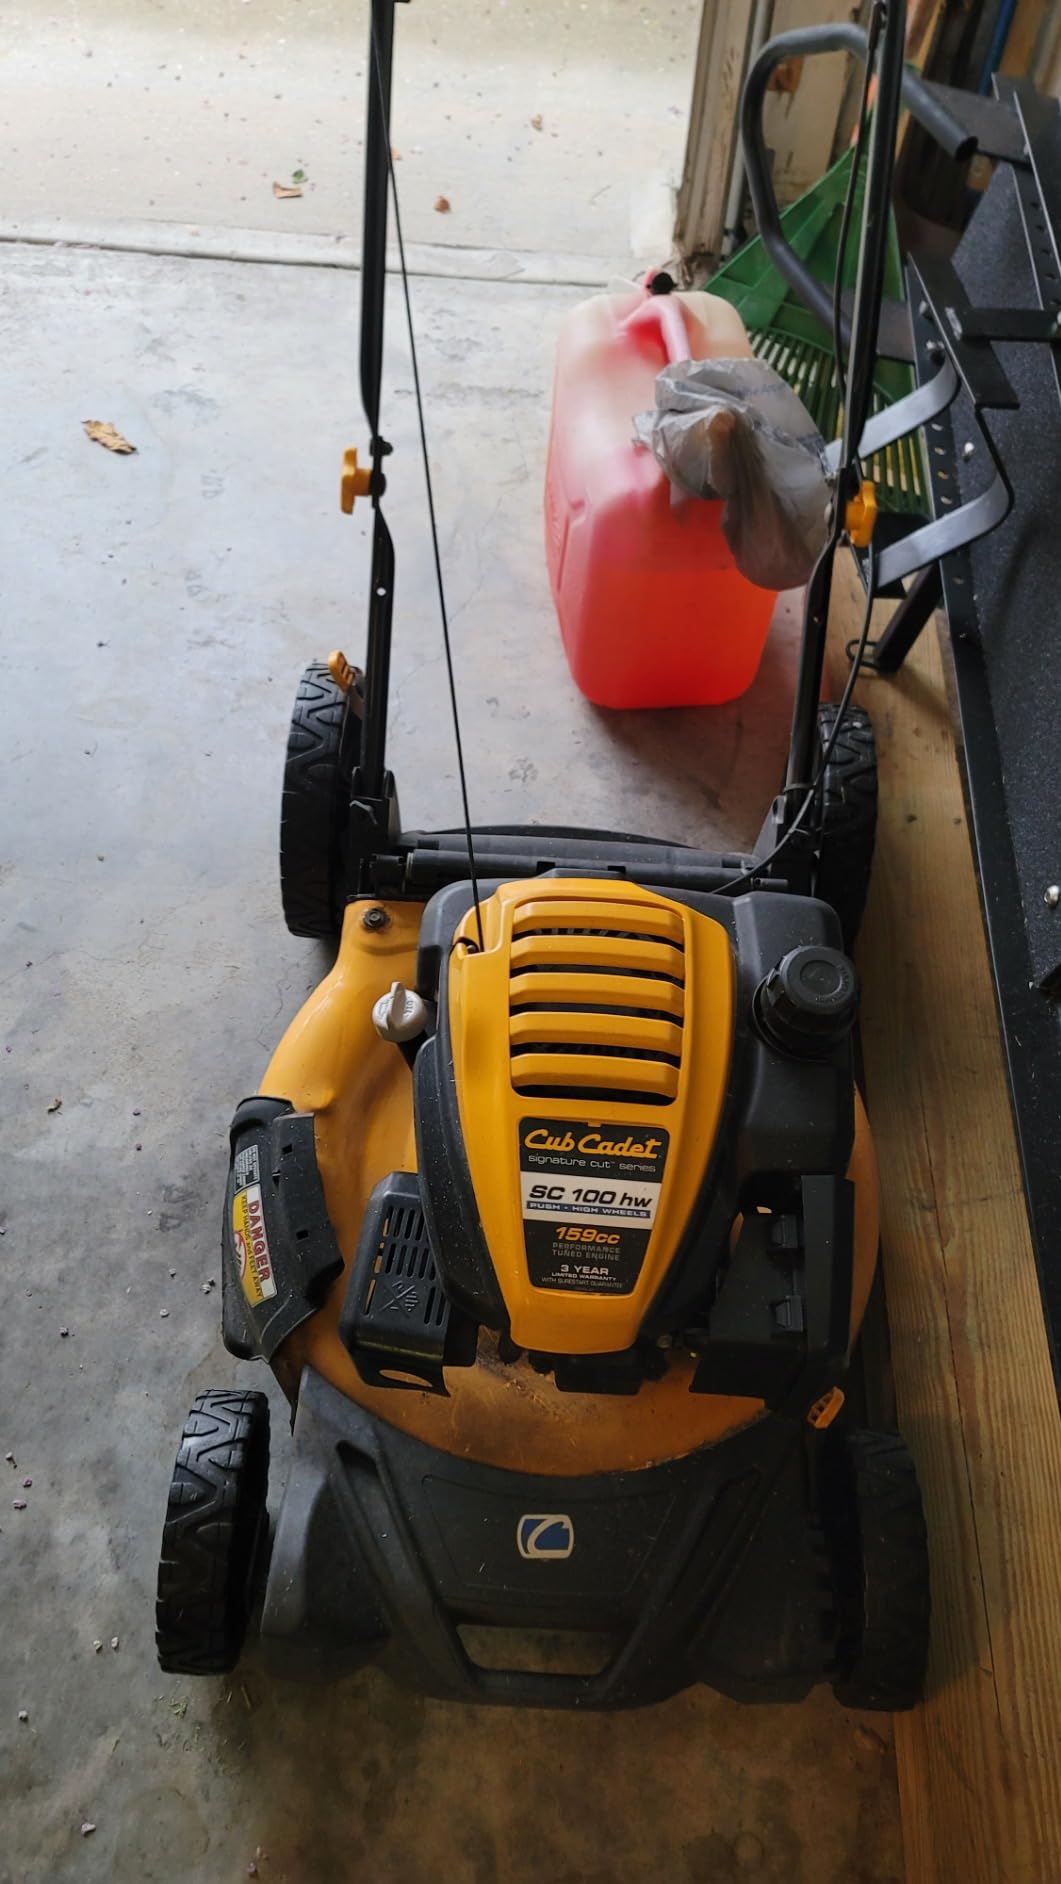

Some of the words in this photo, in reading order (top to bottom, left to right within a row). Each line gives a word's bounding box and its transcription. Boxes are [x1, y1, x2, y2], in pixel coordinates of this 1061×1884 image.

[524, 1128, 576, 1152] Cub
[577, 1133, 662, 1159] Cadet
[528, 1154, 587, 1168] signature
[619, 1163, 657, 1173] series
[529, 1184, 566, 1201] SC
[572, 1188, 617, 1205] 100
[619, 1192, 653, 1208] hw
[529, 1202, 561, 1210] PUSH
[571, 1205, 600, 1213] HIGH
[602, 1208, 648, 1217] WHEELS
[248, 1200, 271, 1282] DANGER
[556, 1226, 620, 1244] 159cc
[552, 1242, 621, 1254] PERFORMANCE
[552, 1249, 582, 1258] TUNED
[585, 1252, 620, 1261] ENGINE
[560, 1264, 569, 1272] 3
[573, 1265, 609, 1275] YEAR
[252, 1276, 262, 1297] AWAY
